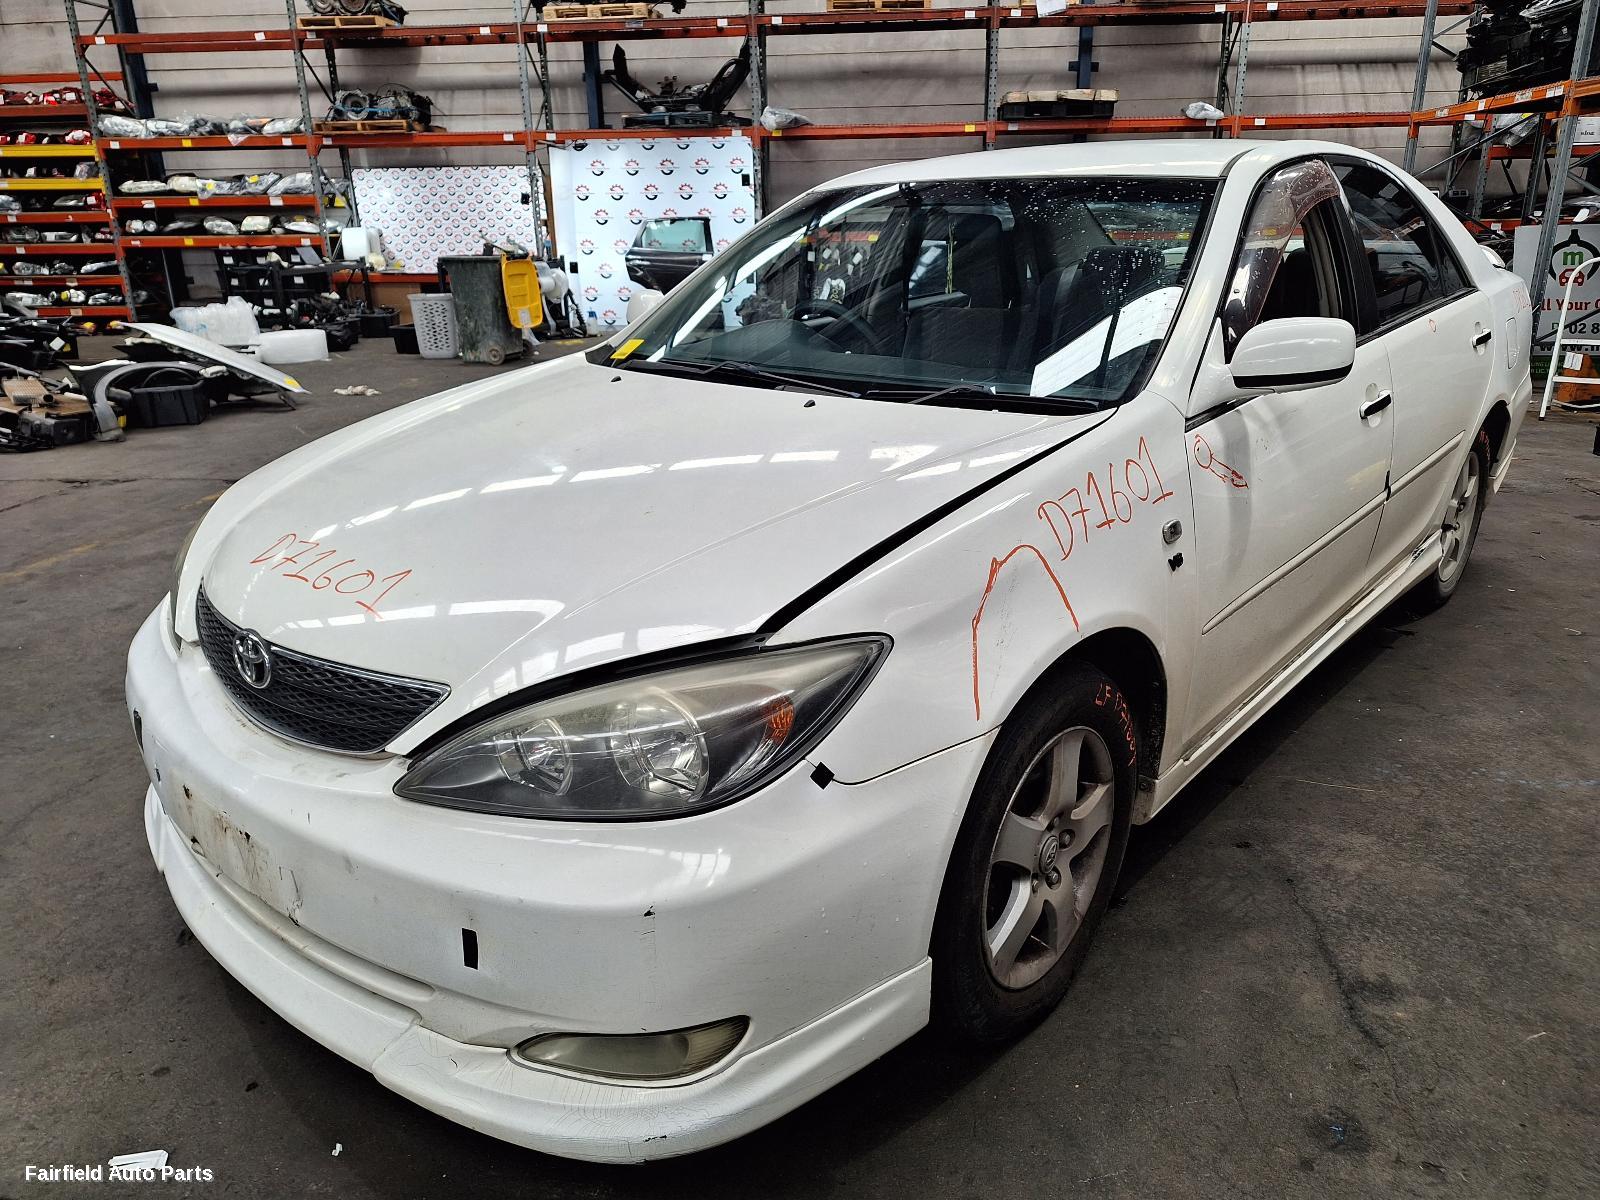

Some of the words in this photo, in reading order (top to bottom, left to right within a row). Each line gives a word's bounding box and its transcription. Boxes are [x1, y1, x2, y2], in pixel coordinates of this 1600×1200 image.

[1568, 322, 1587, 335] 02
[1038, 435, 1174, 561] D71601
[250, 533, 413, 620] D71601
